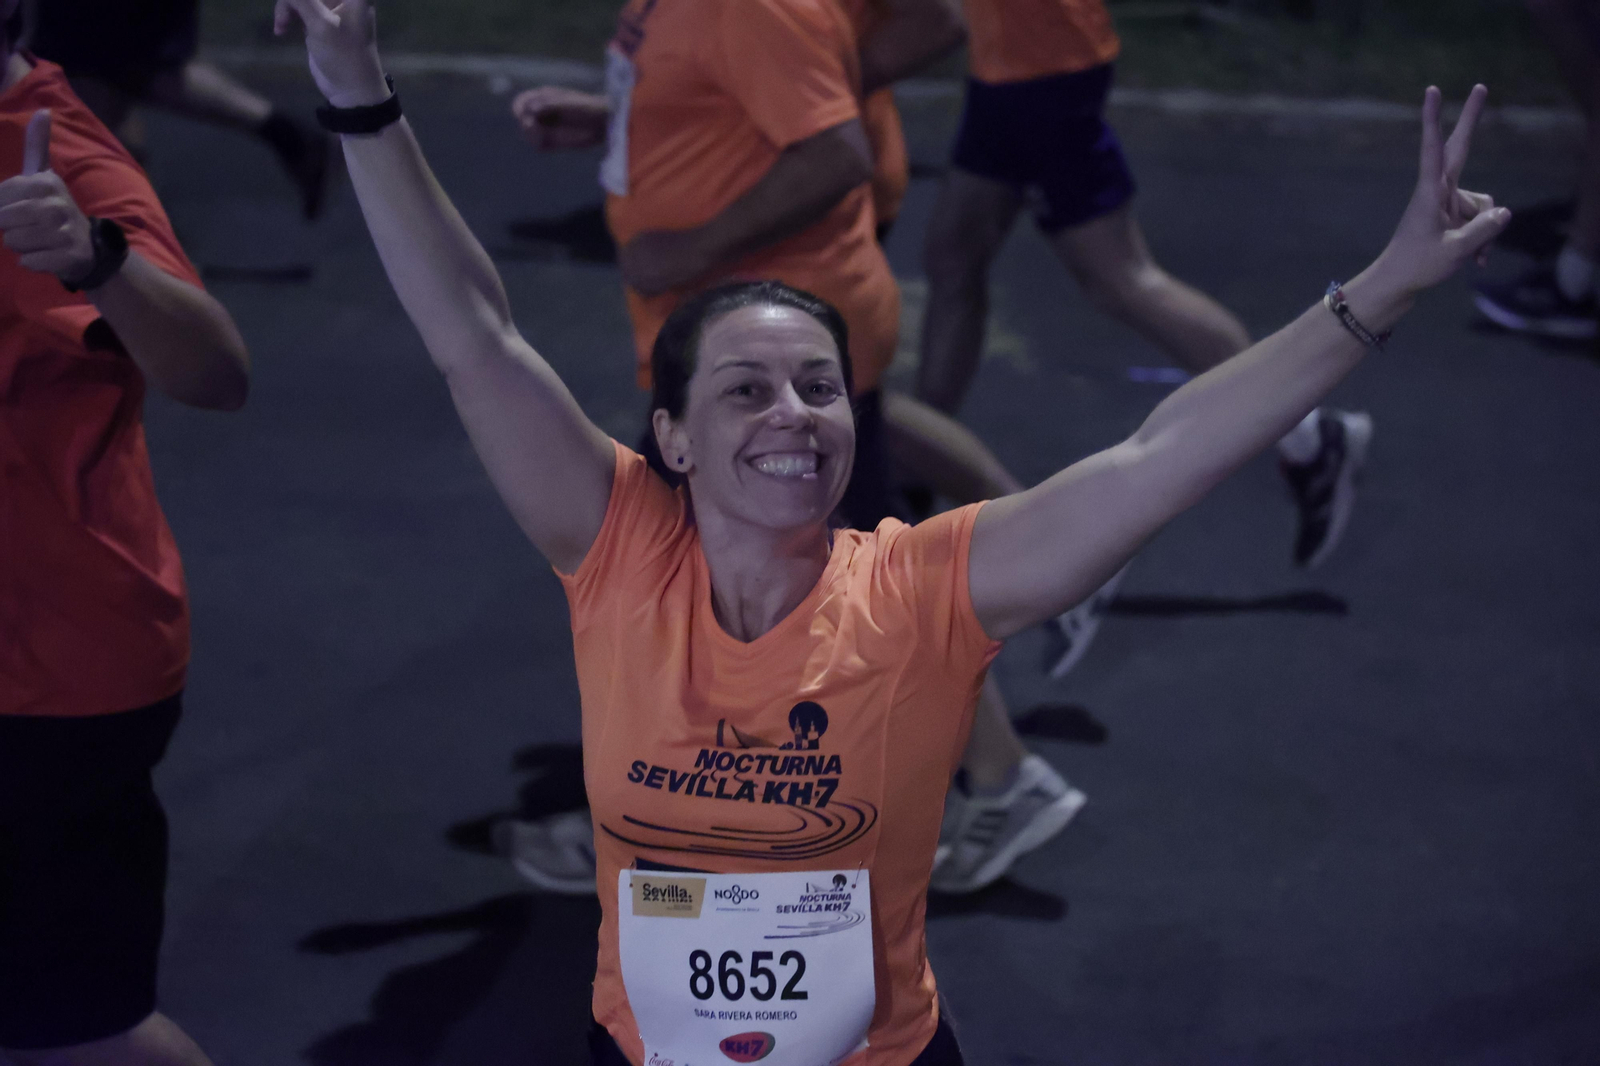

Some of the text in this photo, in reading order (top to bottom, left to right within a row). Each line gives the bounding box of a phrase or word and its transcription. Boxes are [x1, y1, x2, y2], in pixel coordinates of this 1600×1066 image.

[694, 749, 842, 775] NOCTURNA
[627, 760, 757, 804] SEVILLA
[776, 902, 823, 913] SEVILLA
[799, 893, 851, 903] NOCTURNA
[689, 949, 808, 1001] 8652
[694, 1008, 797, 1021] SARA RIVERA ROMERO
